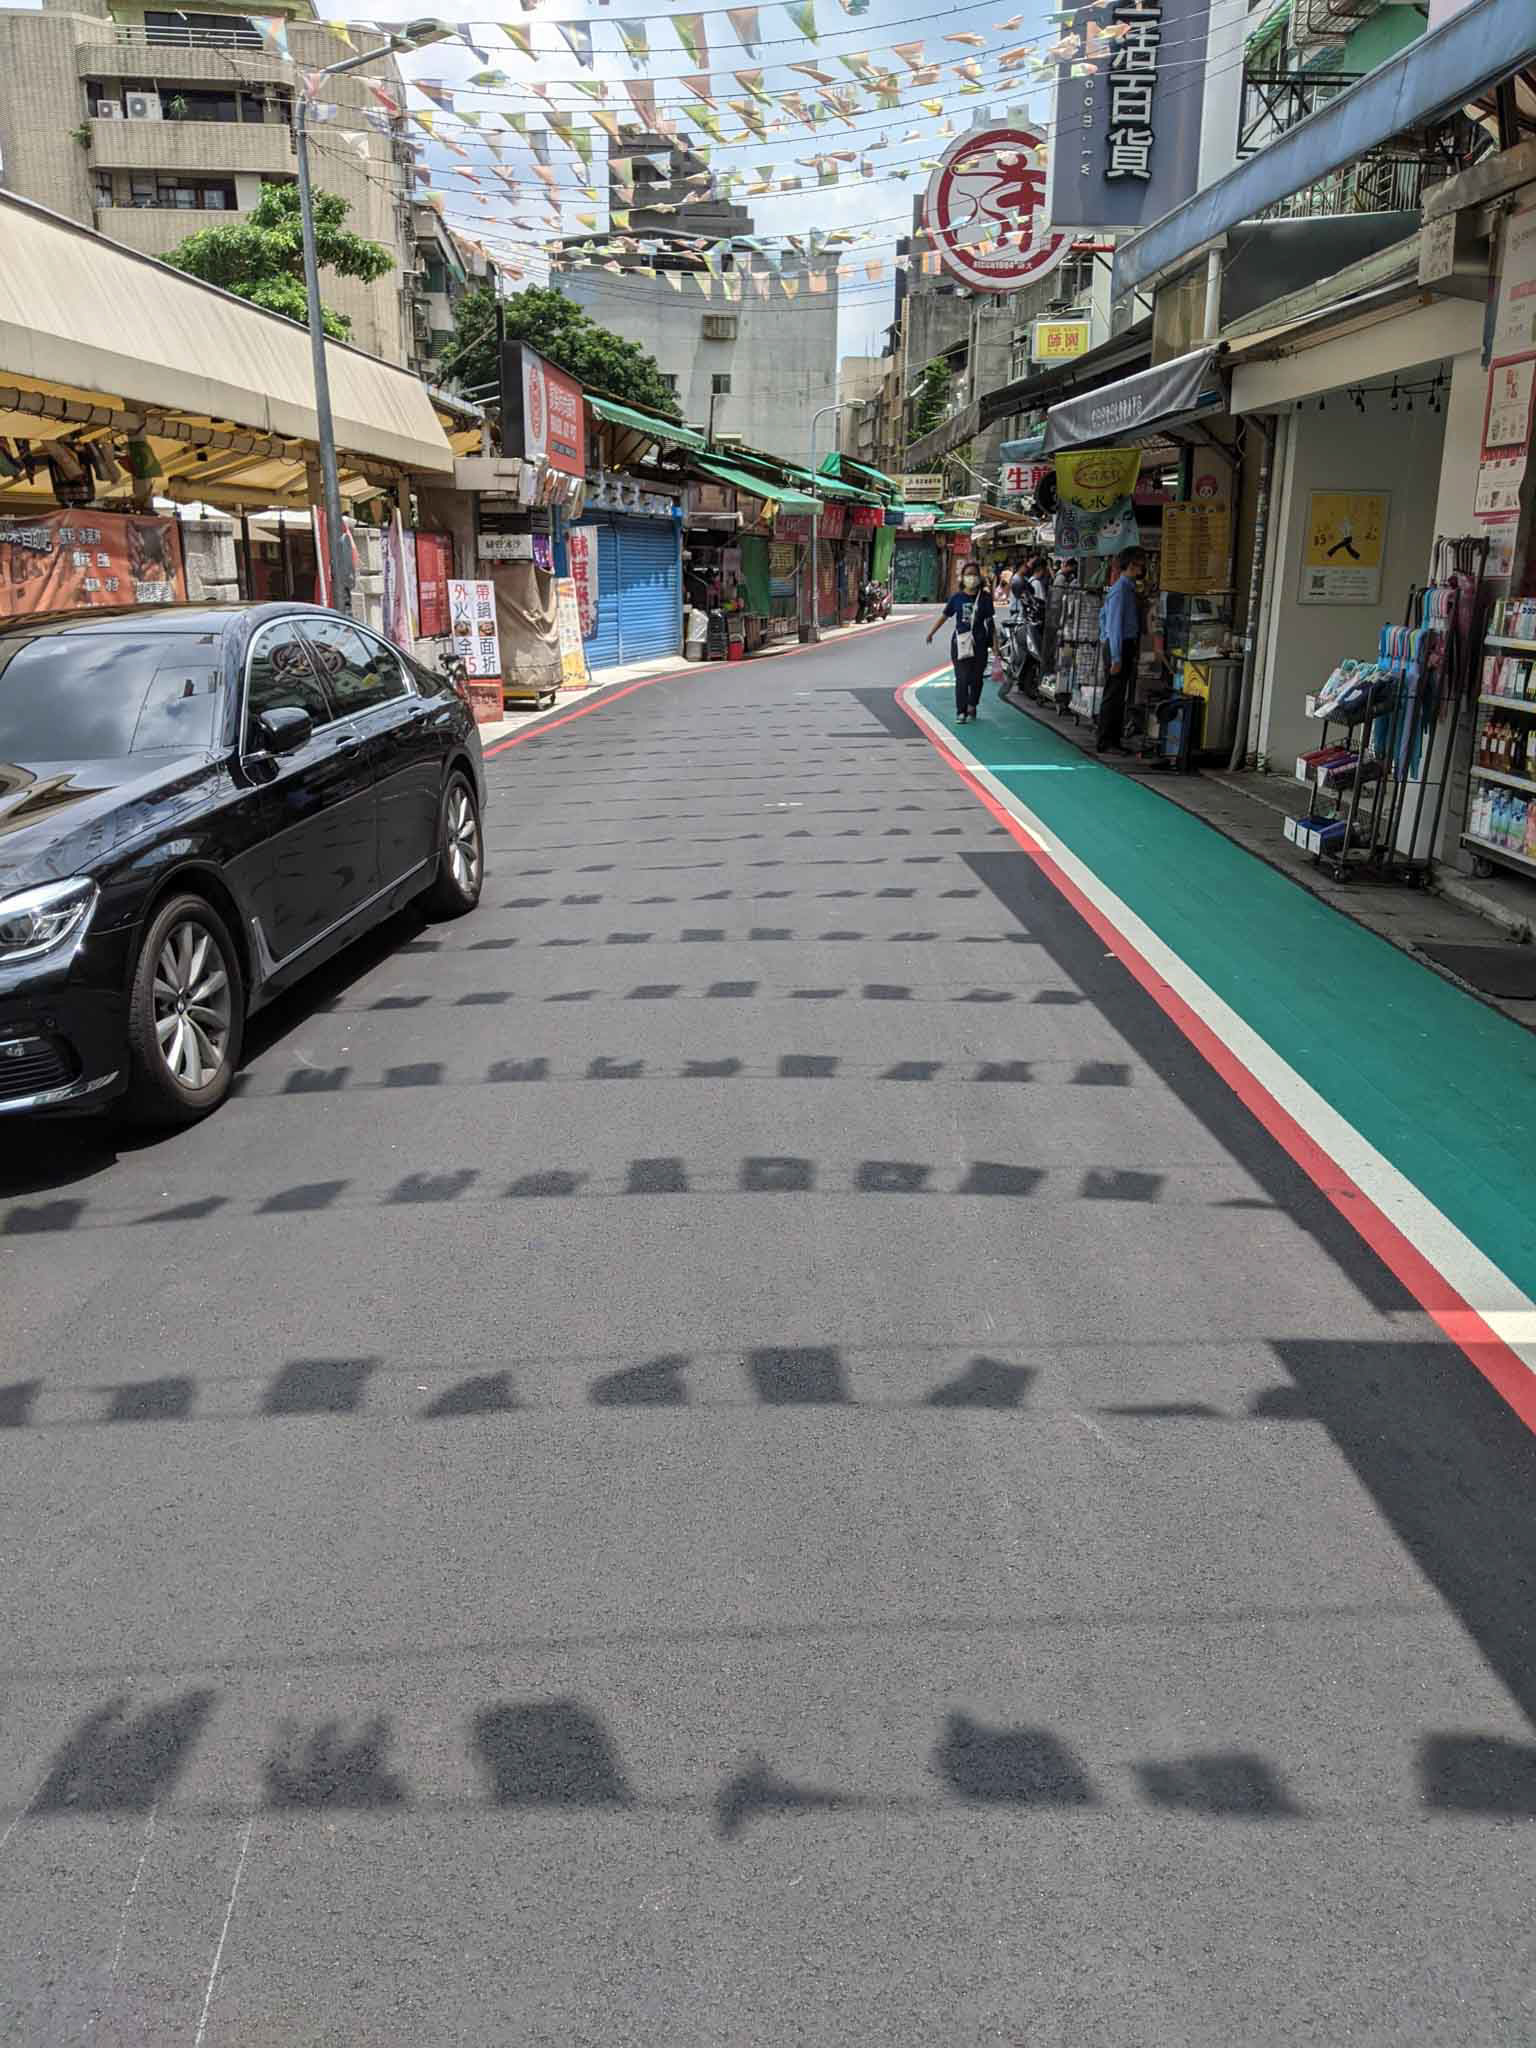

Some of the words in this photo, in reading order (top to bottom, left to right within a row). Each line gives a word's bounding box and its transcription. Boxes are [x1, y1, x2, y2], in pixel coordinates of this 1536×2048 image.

[1107, 0, 1162, 179] 活百貨
[465, 655, 497, 674] 5折
